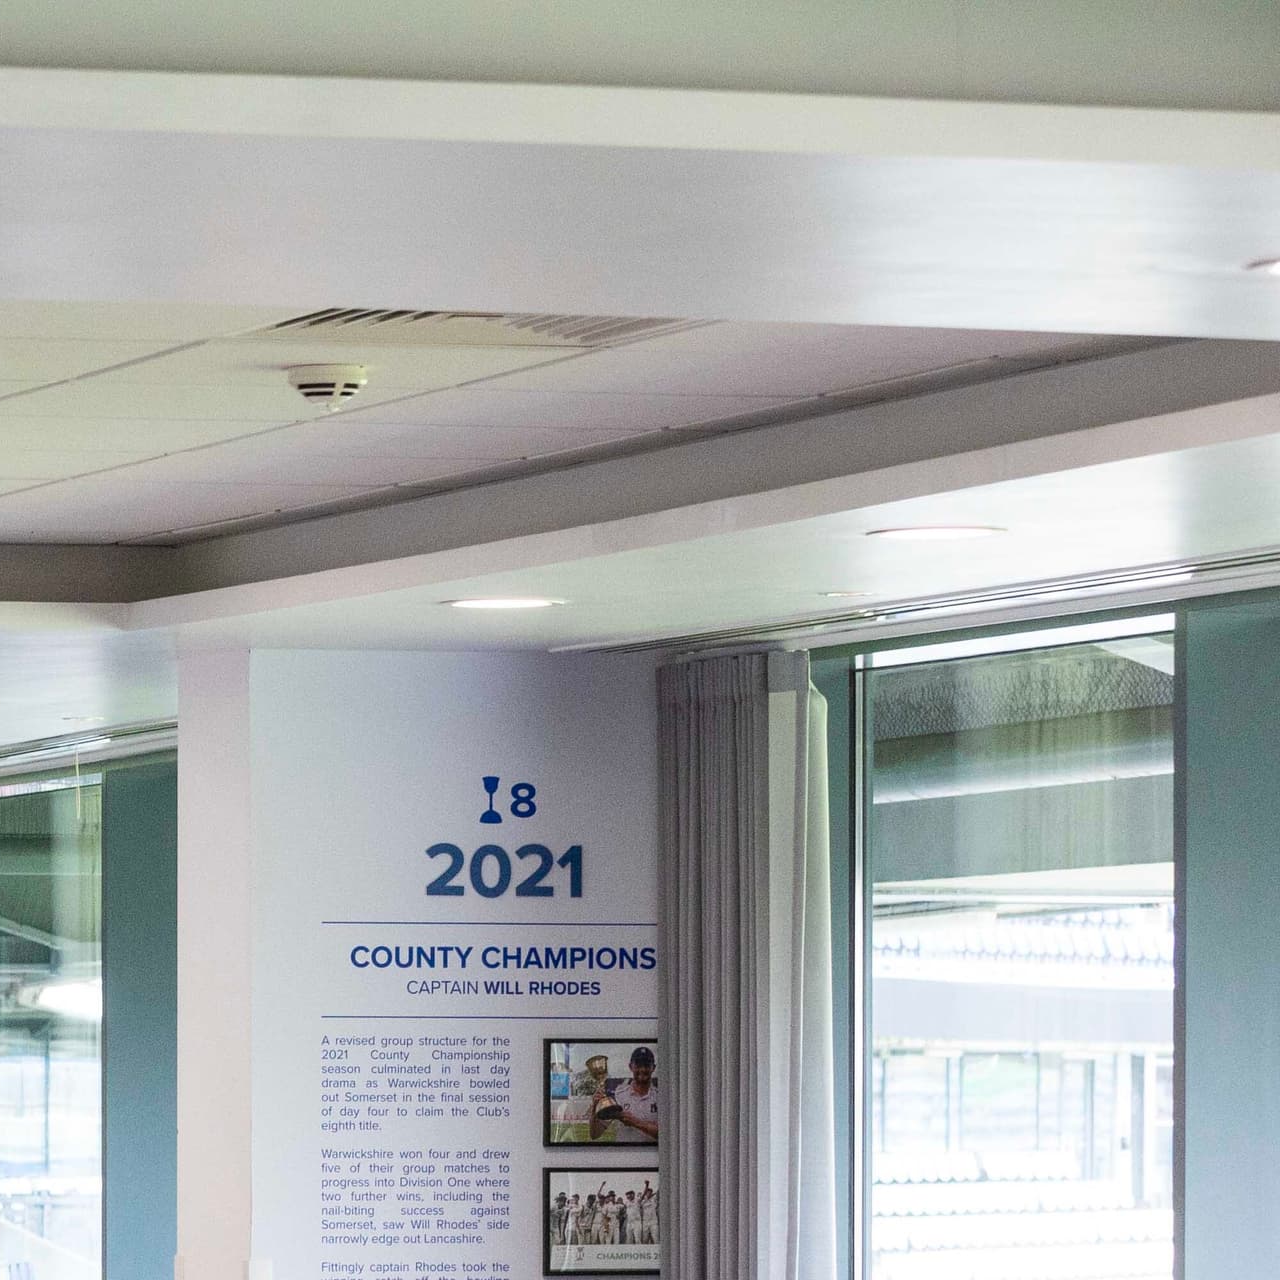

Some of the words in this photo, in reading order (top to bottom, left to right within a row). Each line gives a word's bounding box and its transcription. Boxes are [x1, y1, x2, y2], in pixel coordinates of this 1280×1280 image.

[509, 782, 537, 818] 8
[425, 843, 583, 898] 2021
[350, 946, 473, 969] COUNTY
[481, 946, 657, 970] CHAMPIONS
[406, 980, 478, 995] CAPTAIN
[484, 981, 523, 995] WILL
[529, 981, 601, 996] RHODES
[321, 1035, 330, 1046] A
[335, 1035, 376, 1046] revised
[380, 1038, 414, 1049] group
[418, 1036, 468, 1046] structure
[472, 1035, 487, 1046] for
[492, 1035, 510, 1046] the
[321, 1049, 348, 1060] 2021
[370, 1049, 410, 1063] County
[431, 1049, 511, 1063] Championship
[321, 1066, 361, 1074] season
[371, 1063, 431, 1074] culminated
[441, 1064, 451, 1074] in
[461, 1063, 480, 1074] last
[490, 1063, 511, 1077] day
[321, 1077, 356, 1088] drama
[365, 1080, 378, 1088] as
[387, 1077, 461, 1088] Warwickshire
[469, 1077, 510, 1088] bowled
[321, 1092, 339, 1102] out
[344, 1092, 397, 1102] Somerset
[402, 1092, 412, 1102] in
[417, 1092, 436, 1102] the
[440, 1092, 464, 1102] final
[468, 1092, 510, 1102] session
[321, 1106, 333, 1117] of
[339, 1106, 360, 1120] day
[367, 1106, 390, 1117] four
[396, 1106, 408, 1117] to
[415, 1106, 444, 1117] claim
[451, 1106, 469, 1117] the
[321, 1120, 356, 1134] eighth
[321, 1148, 394, 1159] Warwickshire
[399, 1151, 423, 1159] won
[428, 1148, 451, 1159] four
[455, 1148, 477, 1159] and
[482, 1148, 511, 1159] drew
[321, 1162, 341, 1173] five
[349, 1162, 361, 1173] of
[369, 1162, 394, 1173] their
[402, 1165, 436, 1176] group
[443, 1162, 491, 1173] matches
[498, 1163, 510, 1173] to
[321, 1179, 370, 1190] progress
[374, 1177, 395, 1187] into
[399, 1176, 443, 1187] Division
[447, 1176, 471, 1187] One
[475, 1176, 510, 1187] where
[321, 1191, 342, 1201] two
[350, 1191, 387, 1201] further
[433, 1191, 483, 1204] including
[492, 1191, 510, 1201] the
[321, 1205, 375, 1218] nail-biting
[400, 1207, 445, 1215] success
[470, 1205, 510, 1218] against
[382, 1221, 405, 1230] saw
[410, 1219, 430, 1230] Will
[486, 1219, 510, 1230] side
[321, 1233, 369, 1247] narrowly
[371, 1233, 400, 1247] edge
[403, 1233, 421, 1244] out
[321, 1261, 365, 1275] Fittingly
[369, 1262, 410, 1275] captain
[415, 1261, 457, 1272] Rhodes
[462, 1261, 487, 1272] took
[492, 1261, 510, 1272] the
